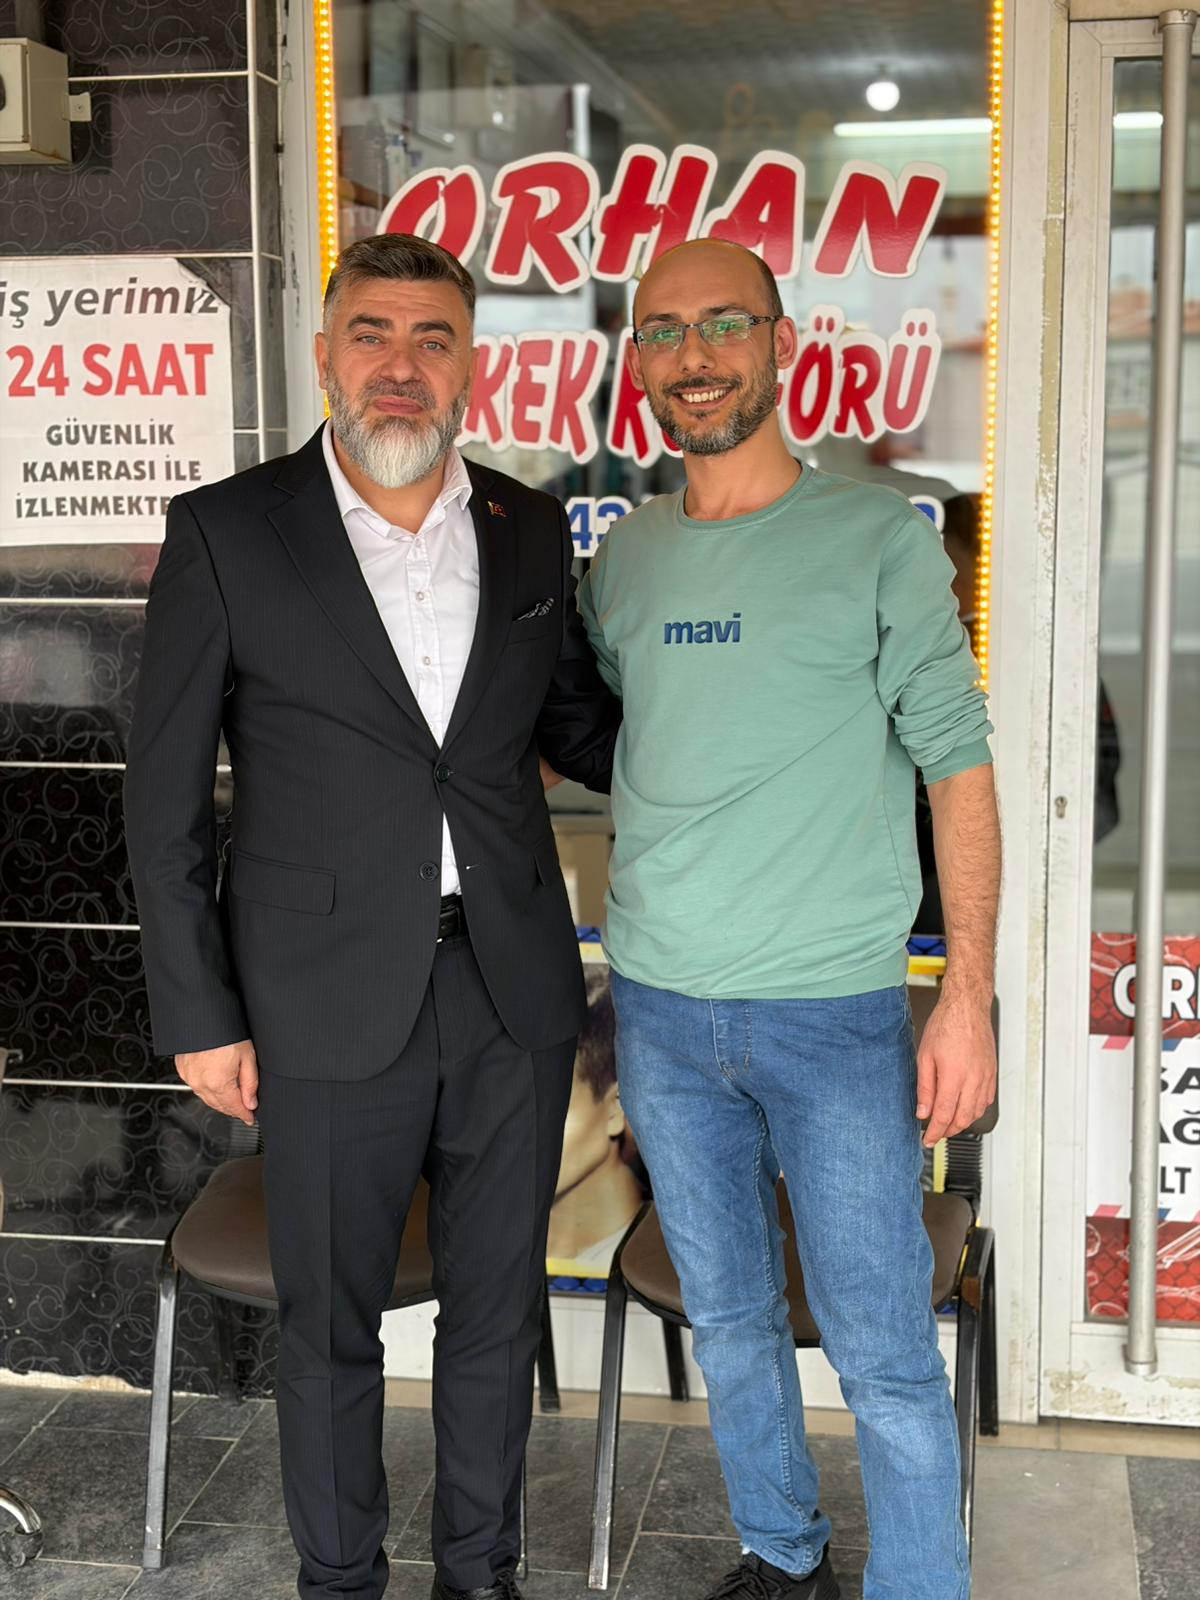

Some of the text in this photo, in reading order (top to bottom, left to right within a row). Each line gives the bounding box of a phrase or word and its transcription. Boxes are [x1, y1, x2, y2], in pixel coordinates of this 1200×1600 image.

[384, 154, 943, 286] ORHAN
[43, 278, 218, 326] yerimiz
[6, 343, 214, 397] 24 SAAT
[465, 315, 933, 460] KEK KÖRÜ
[46, 418, 175, 446] GÜVENLİK
[23, 454, 202, 483] KAMERASI İLE
[664, 612, 741, 644] mavi
